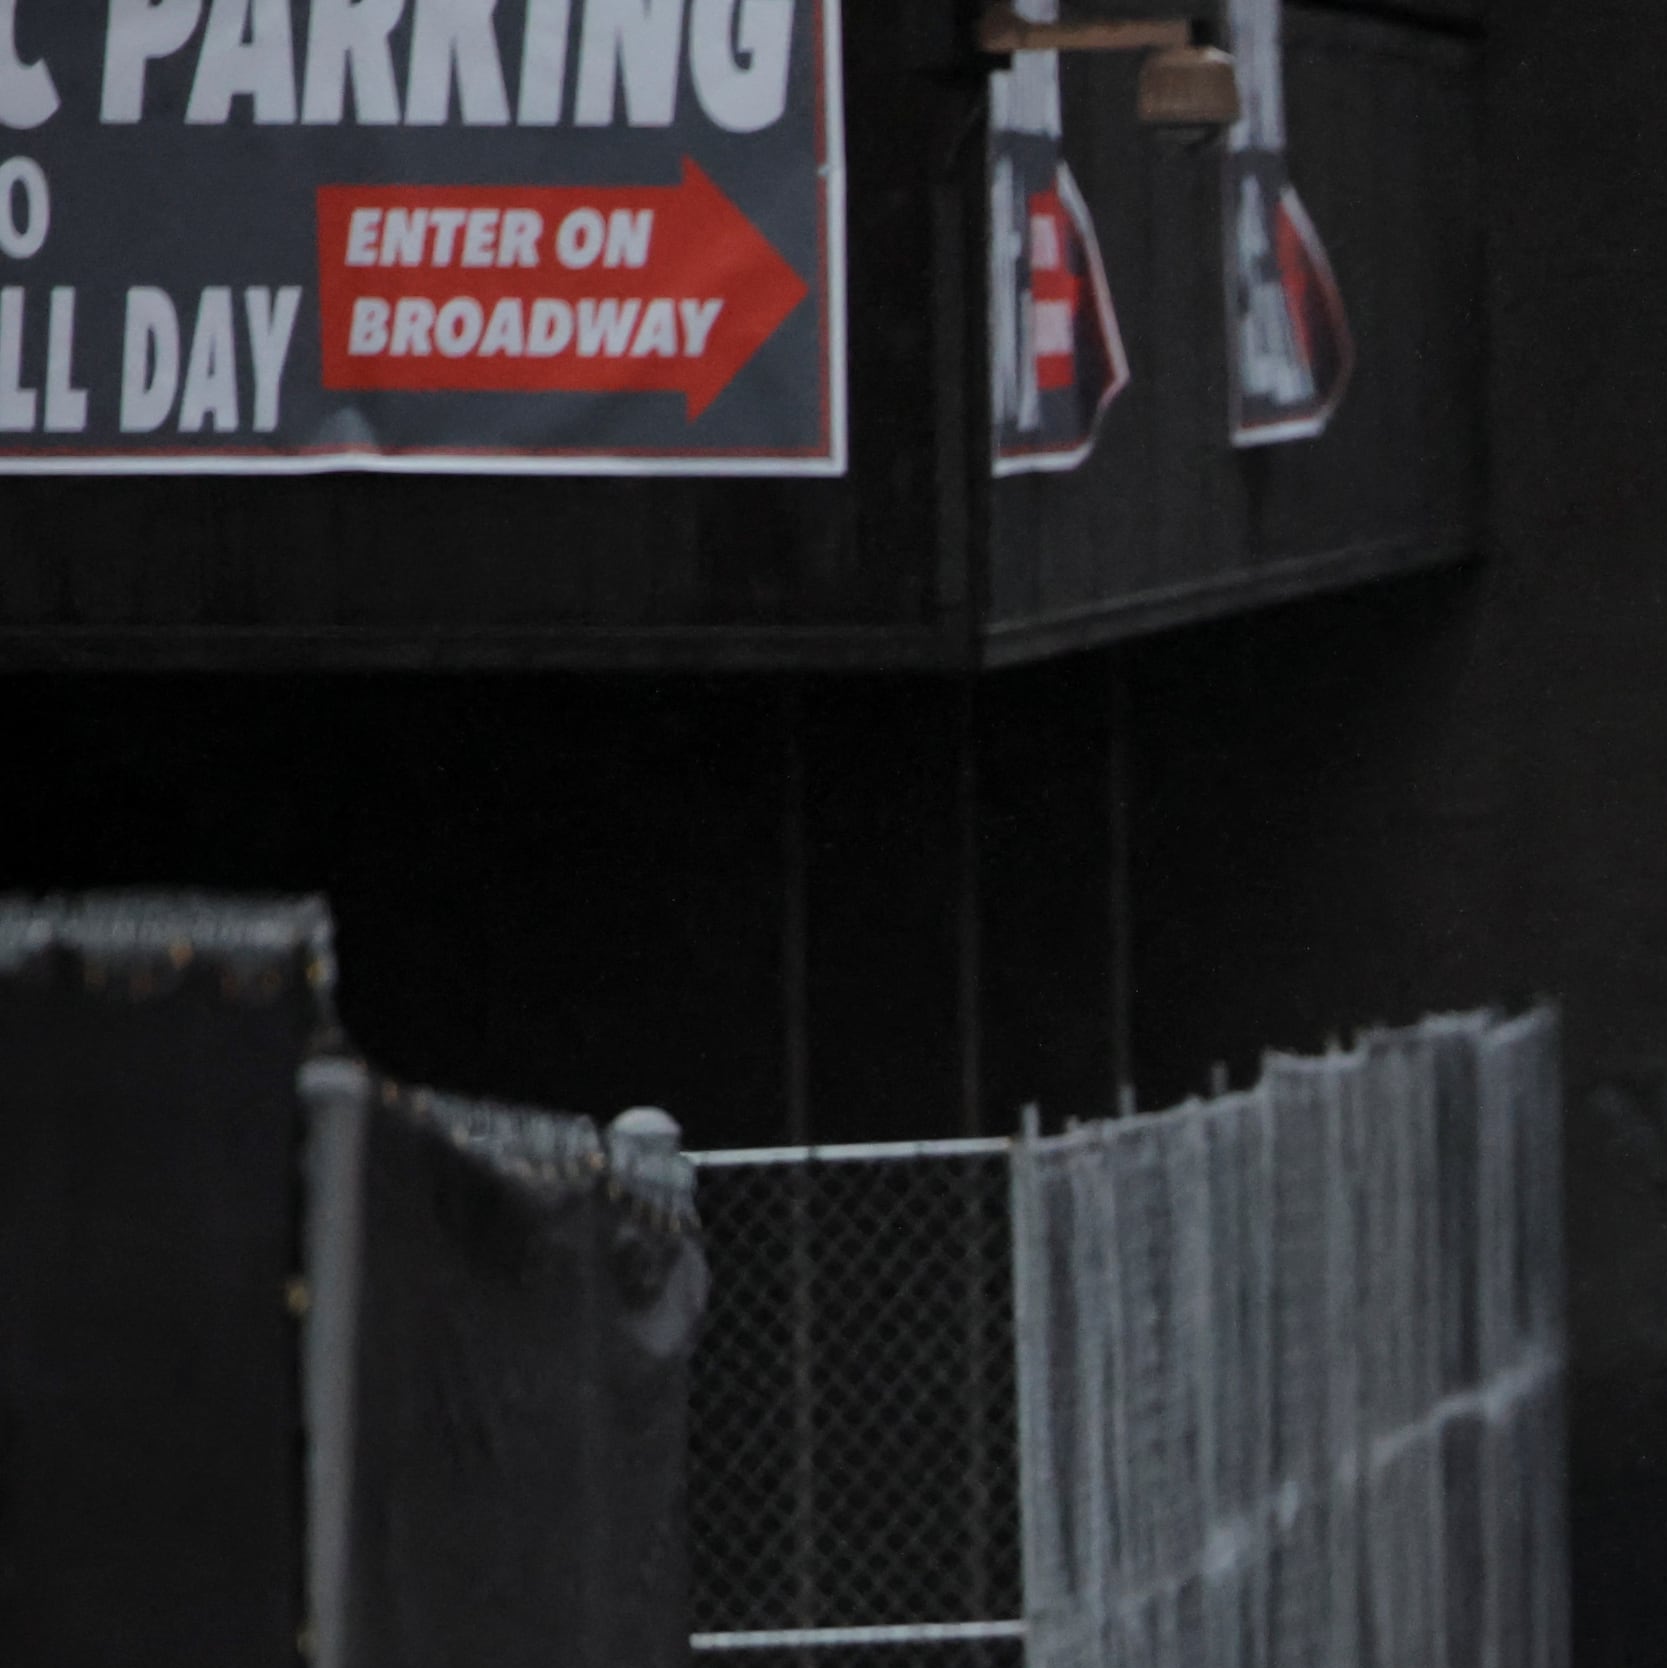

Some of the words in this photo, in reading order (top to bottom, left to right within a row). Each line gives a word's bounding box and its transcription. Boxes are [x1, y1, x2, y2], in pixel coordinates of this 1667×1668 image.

[100, 0, 796, 132] PARKING
[345, 207, 543, 267] ENTER
[556, 207, 653, 269] ON
[119, 285, 302, 433] DAY
[347, 297, 724, 358] BROADWAY
